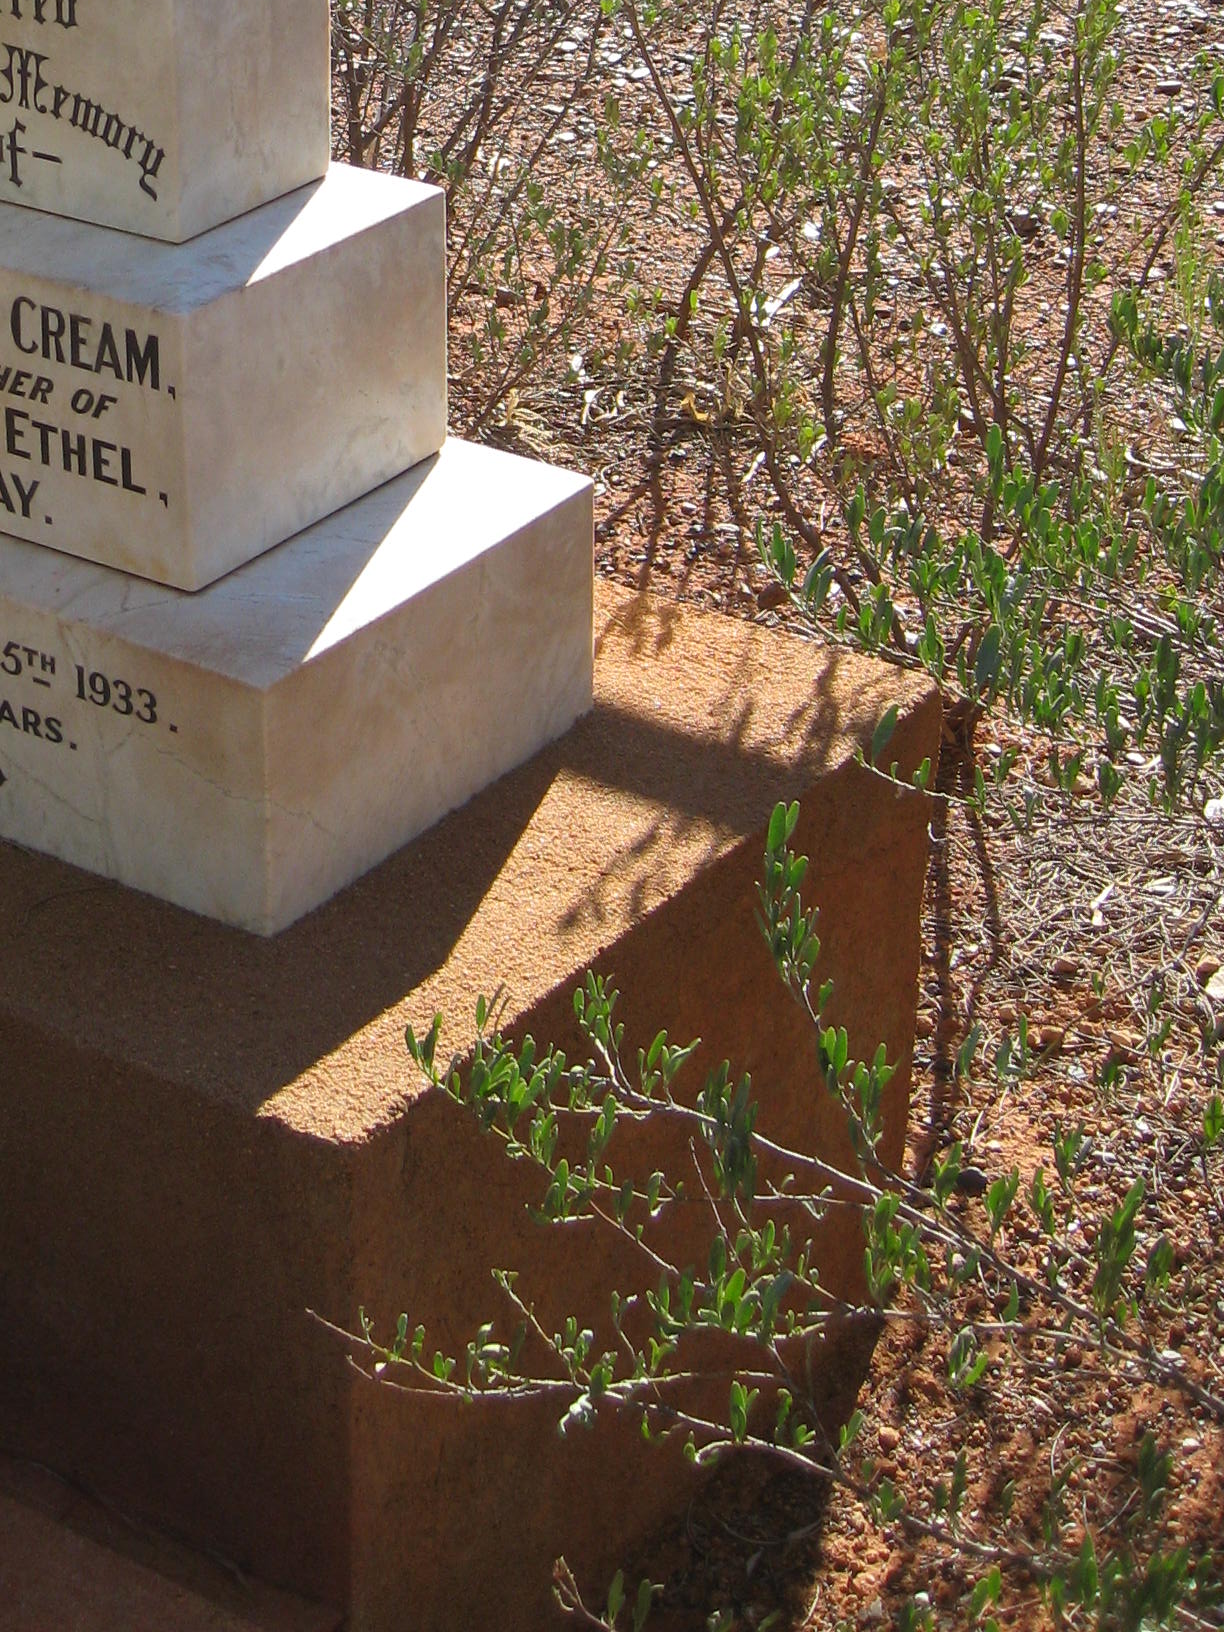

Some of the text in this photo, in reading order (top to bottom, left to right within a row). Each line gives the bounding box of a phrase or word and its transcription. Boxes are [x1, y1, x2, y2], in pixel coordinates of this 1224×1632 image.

[0, 43, 166, 202] Memory
[10, 295, 176, 401] CREAM,
[70, 387, 118, 419] OF
[4, 406, 170, 509] ETHEL,
[75, 664, 179, 734] 1933.
